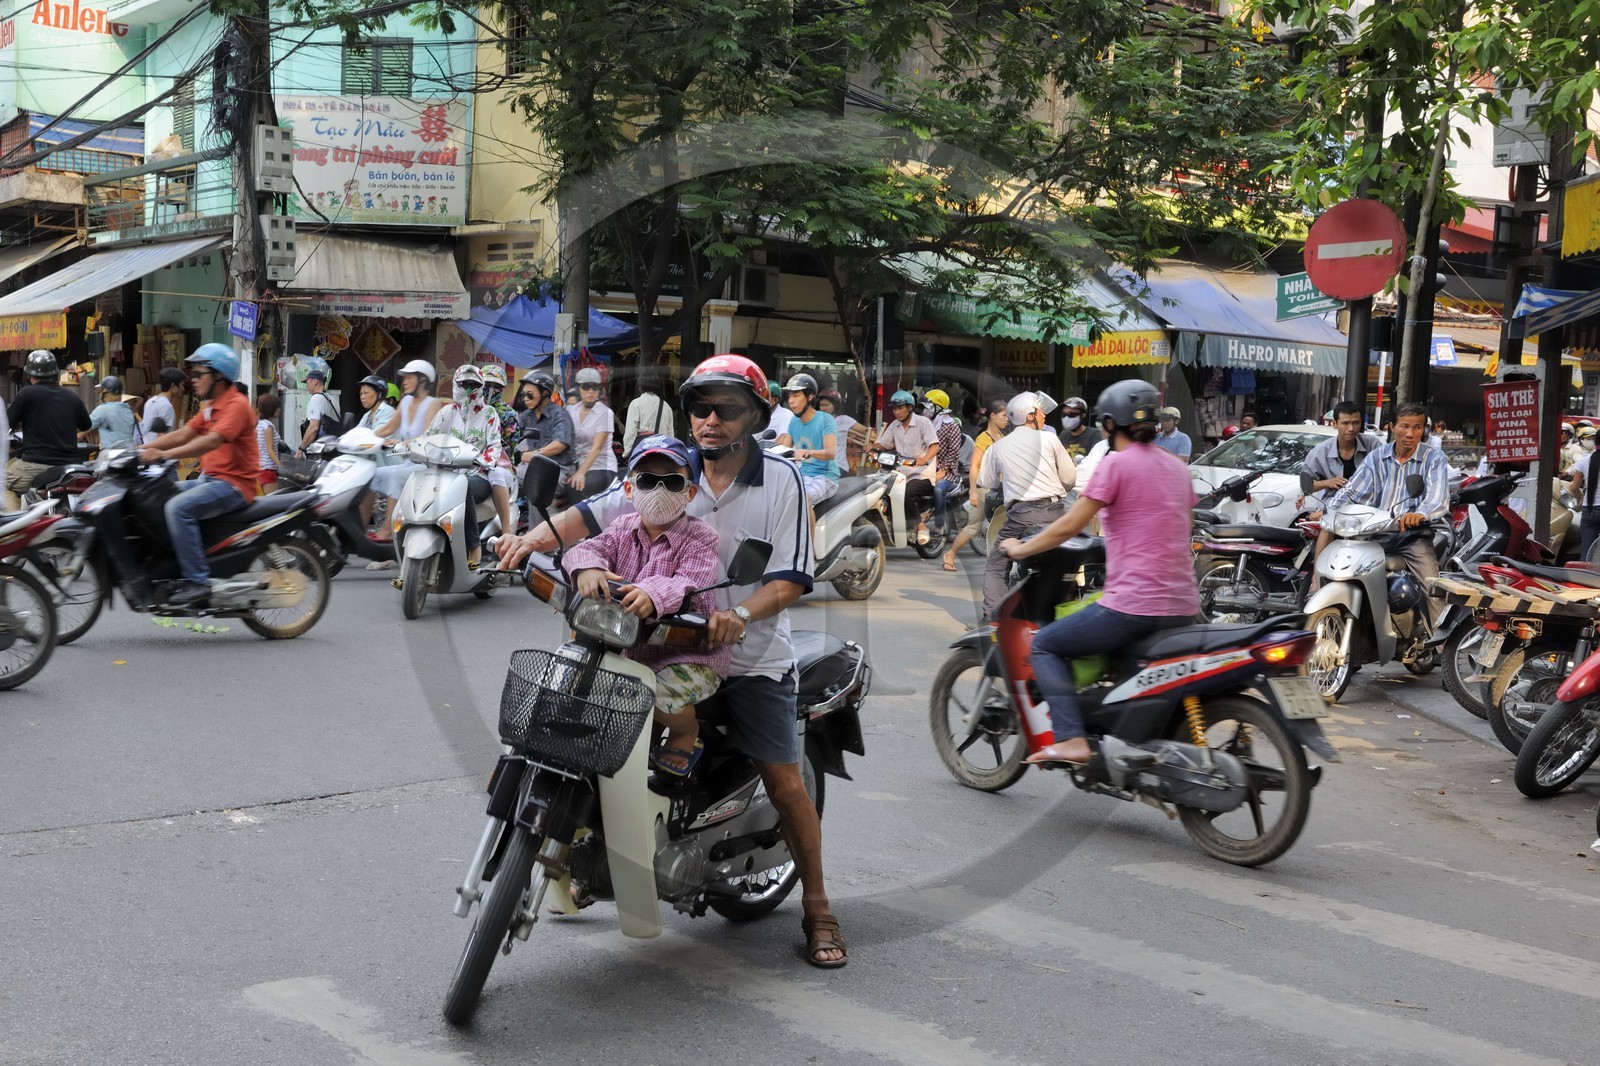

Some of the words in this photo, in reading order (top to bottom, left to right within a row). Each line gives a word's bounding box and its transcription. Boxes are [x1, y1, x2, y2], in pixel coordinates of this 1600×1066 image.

[310, 116, 348, 141] Tạo
[353, 119, 408, 138] Mẫu
[292, 146, 330, 167] rang
[360, 144, 416, 169] phông
[368, 170, 388, 180] Bán
[423, 171, 443, 181] bán
[1288, 290, 1327, 304] TOILE
[1087, 339, 1106, 357] MAI
[1108, 338, 1126, 358] ĐẠI
[1128, 335, 1149, 358] LỘC
[1227, 338, 1274, 363] HAPRO
[1276, 346, 1314, 366] MART
[1487, 391, 1509, 409] SIM
[1511, 384, 1535, 407] THẺ
[1490, 410, 1509, 419] CÁC
[1511, 409, 1533, 418] LOẠI
[1498, 419, 1527, 428] VINA
[1496, 428, 1528, 437] MOBI
[1489, 437, 1536, 446] VIETTEL
[1526, 446, 1538, 456] 200
